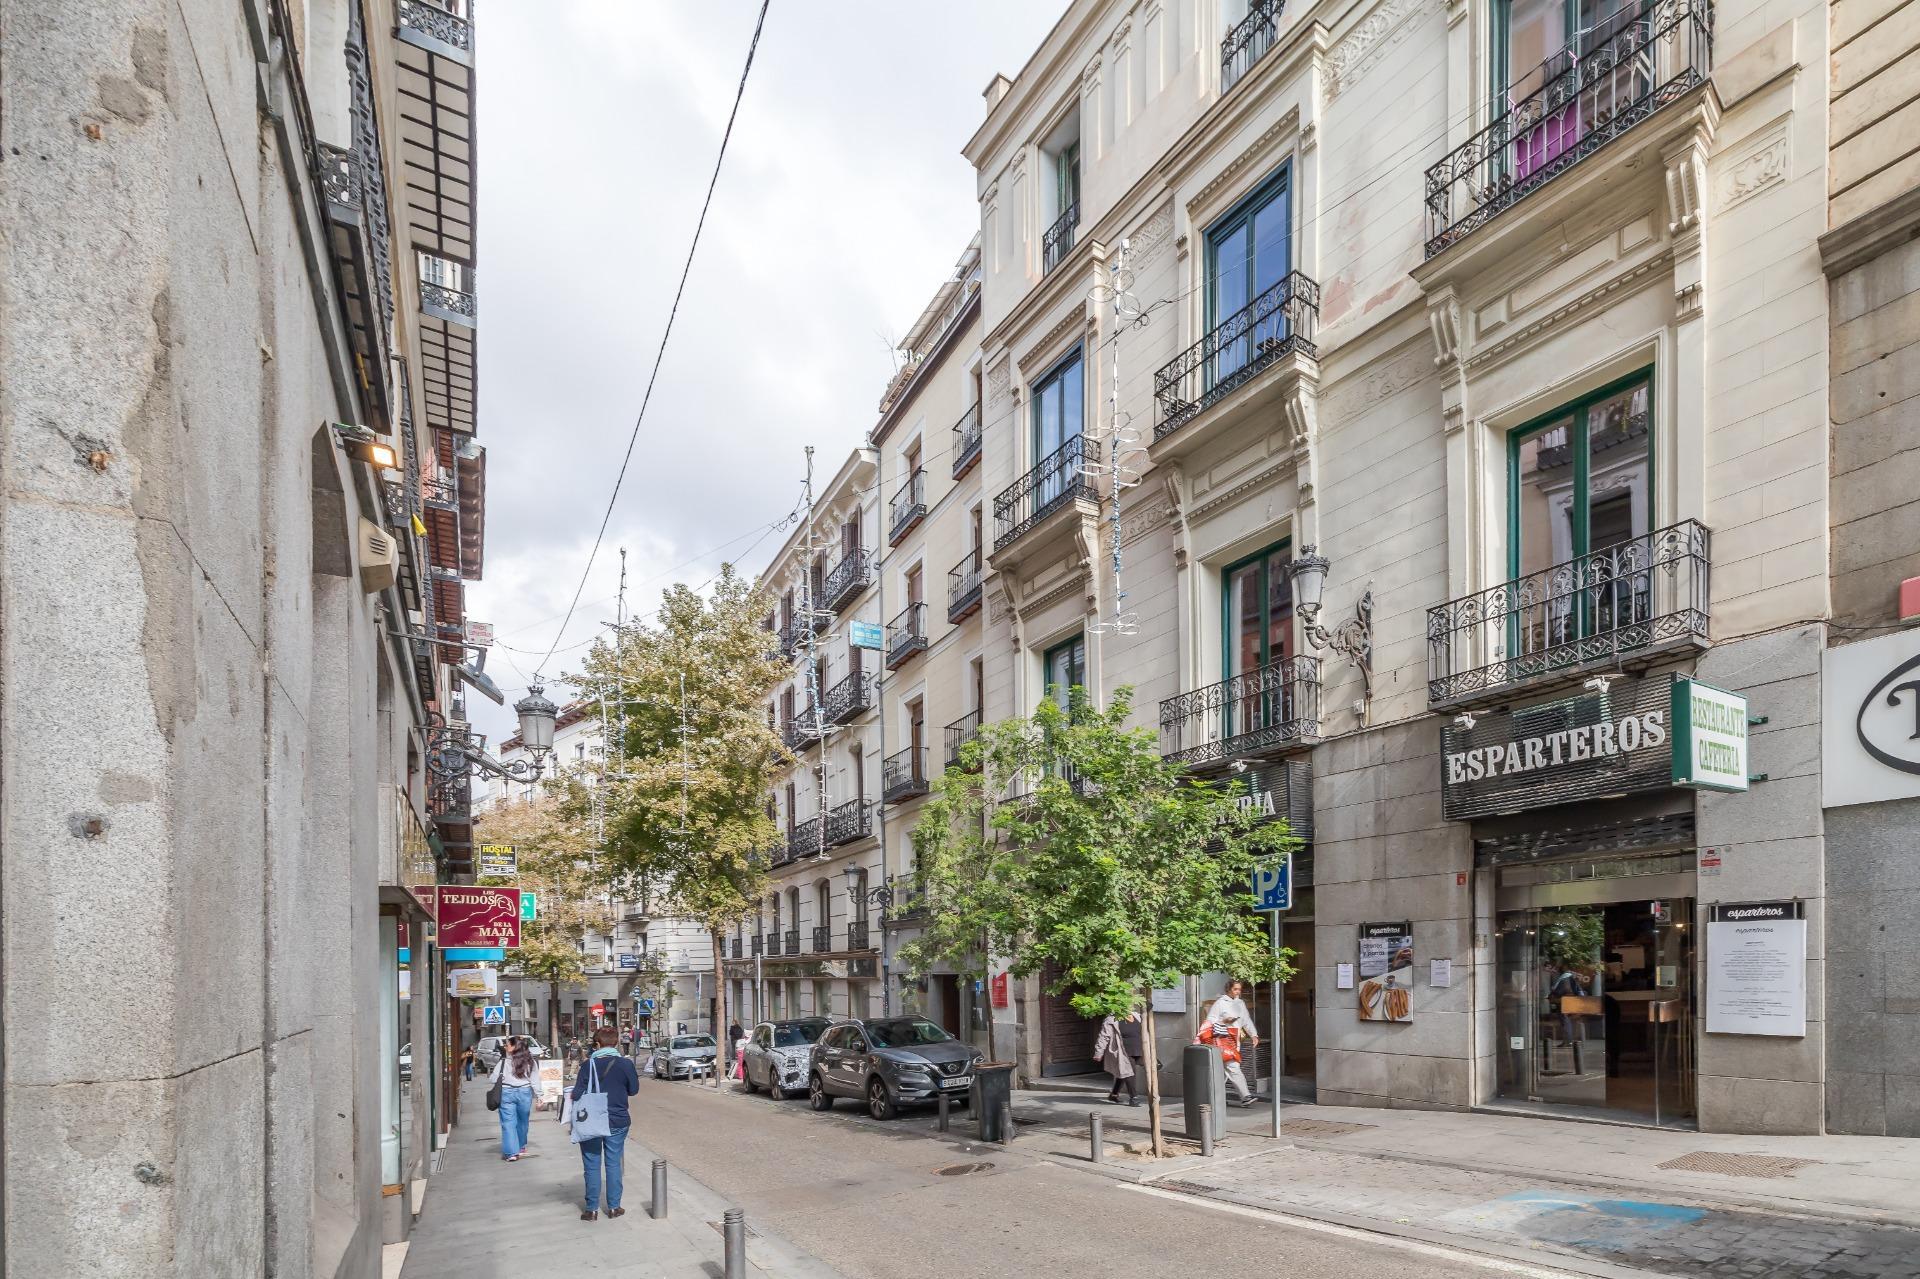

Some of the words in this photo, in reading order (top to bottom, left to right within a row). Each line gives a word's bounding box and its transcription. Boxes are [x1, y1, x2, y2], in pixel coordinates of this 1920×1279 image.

[1692, 695, 1745, 738] RESTAURANTE
[1447, 710, 1667, 785] ESPARTEROS
[482, 845, 515, 854] HOSTAL
[1257, 864, 1280, 905] P
[442, 894, 496, 905] TEJIDOS
[1268, 895, 1273, 904] 2
[1727, 906, 1784, 919] esparteros
[478, 927, 516, 937] MAJA
